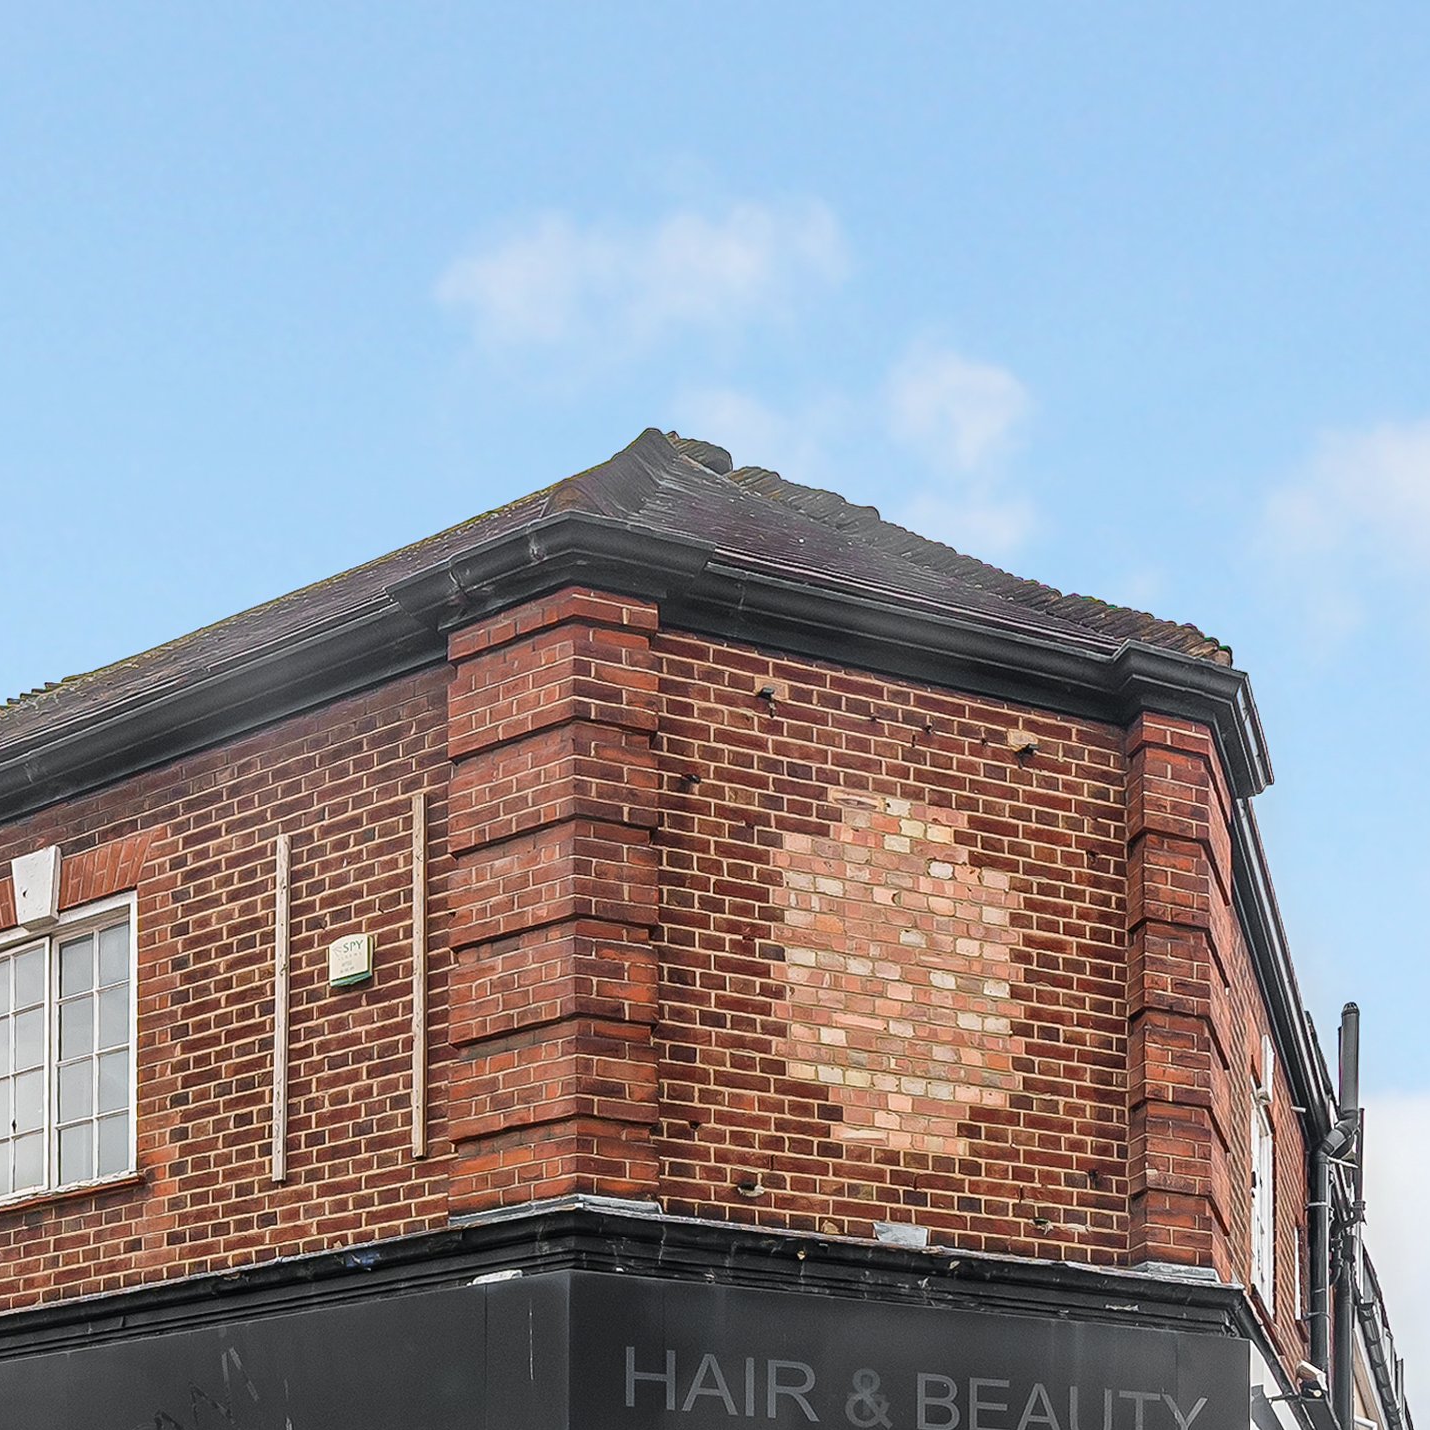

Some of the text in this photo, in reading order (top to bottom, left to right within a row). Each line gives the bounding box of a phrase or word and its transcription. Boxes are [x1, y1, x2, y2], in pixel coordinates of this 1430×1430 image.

[343, 939, 364, 953] SPY
[624, 1346, 820, 1422] HAIR
[844, 1368, 894, 1429] &
